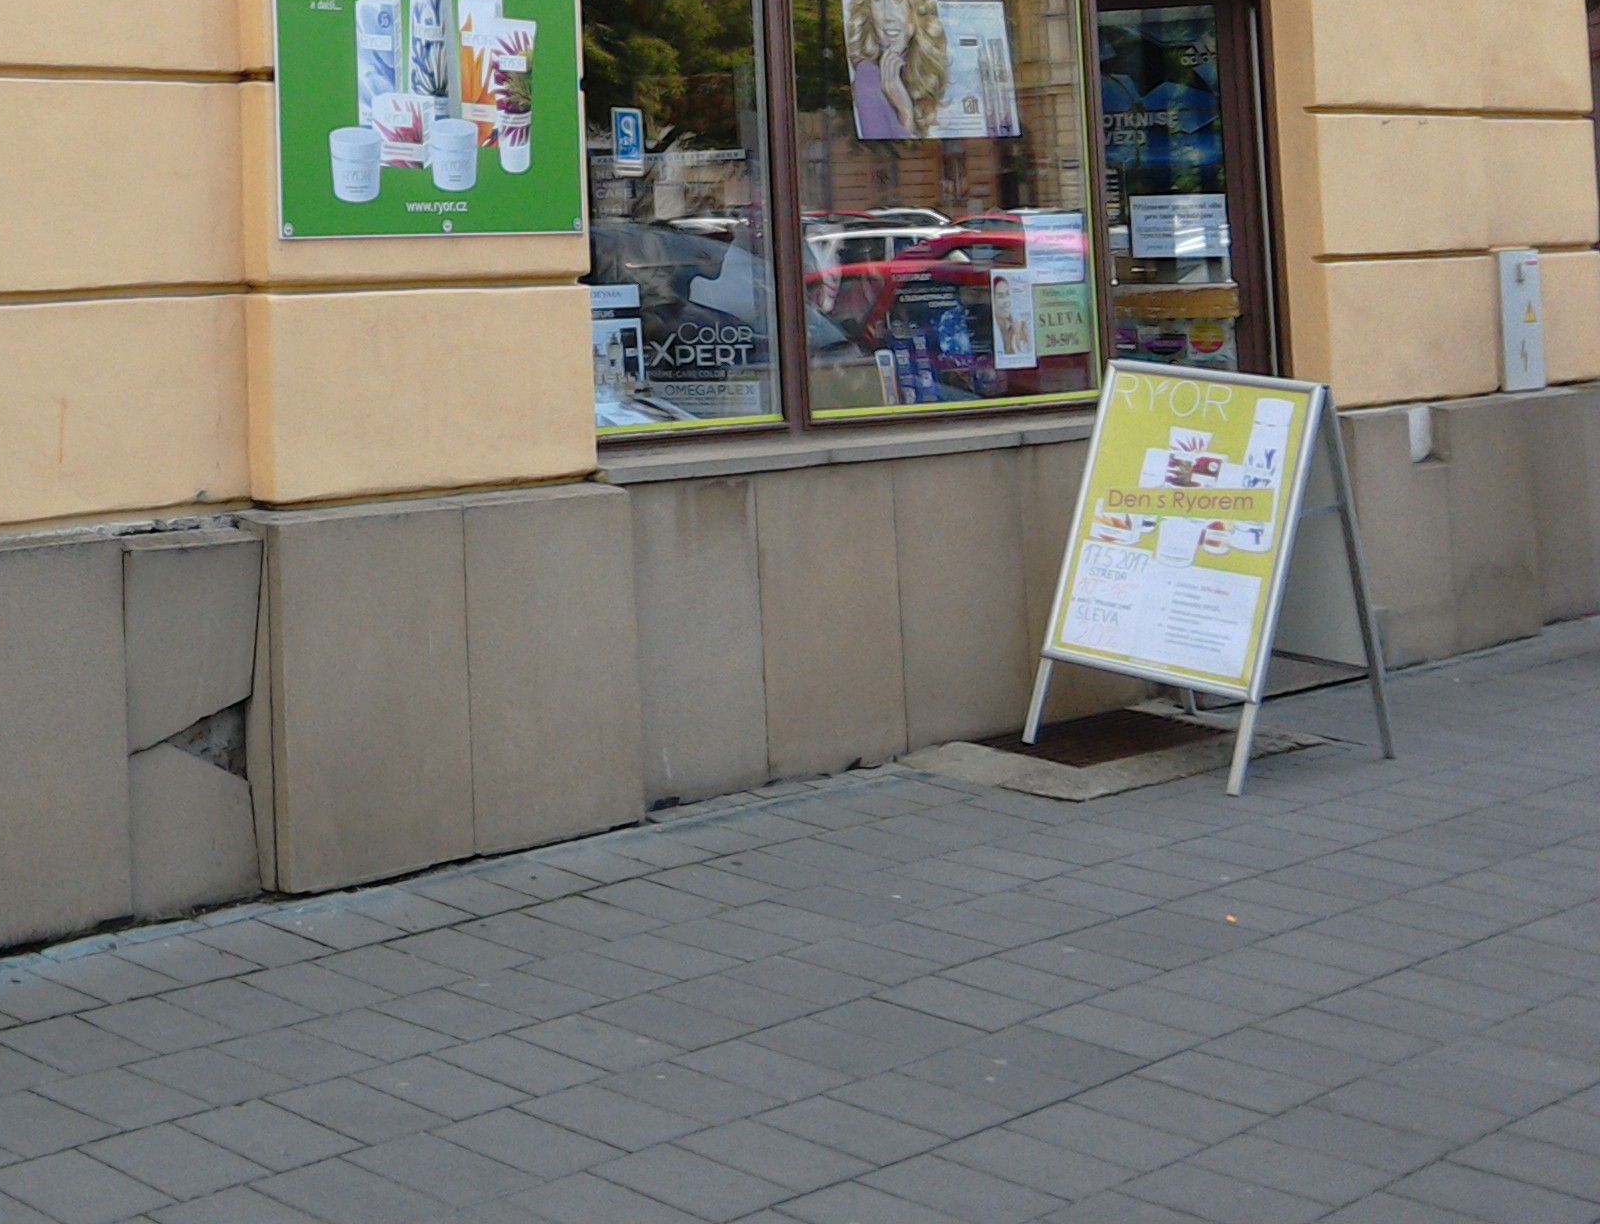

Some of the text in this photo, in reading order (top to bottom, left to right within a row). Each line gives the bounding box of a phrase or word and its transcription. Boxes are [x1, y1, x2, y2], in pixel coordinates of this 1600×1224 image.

[1102, 112, 1154, 128] OTKNI
[405, 201, 468, 215] www.ryor.cz
[1039, 310, 1084, 327] SLEVA
[664, 384, 755, 396] OMEGAPLEX
[1109, 373, 1233, 423] RYOR
[1108, 489, 1255, 521] Den s Ryorem
